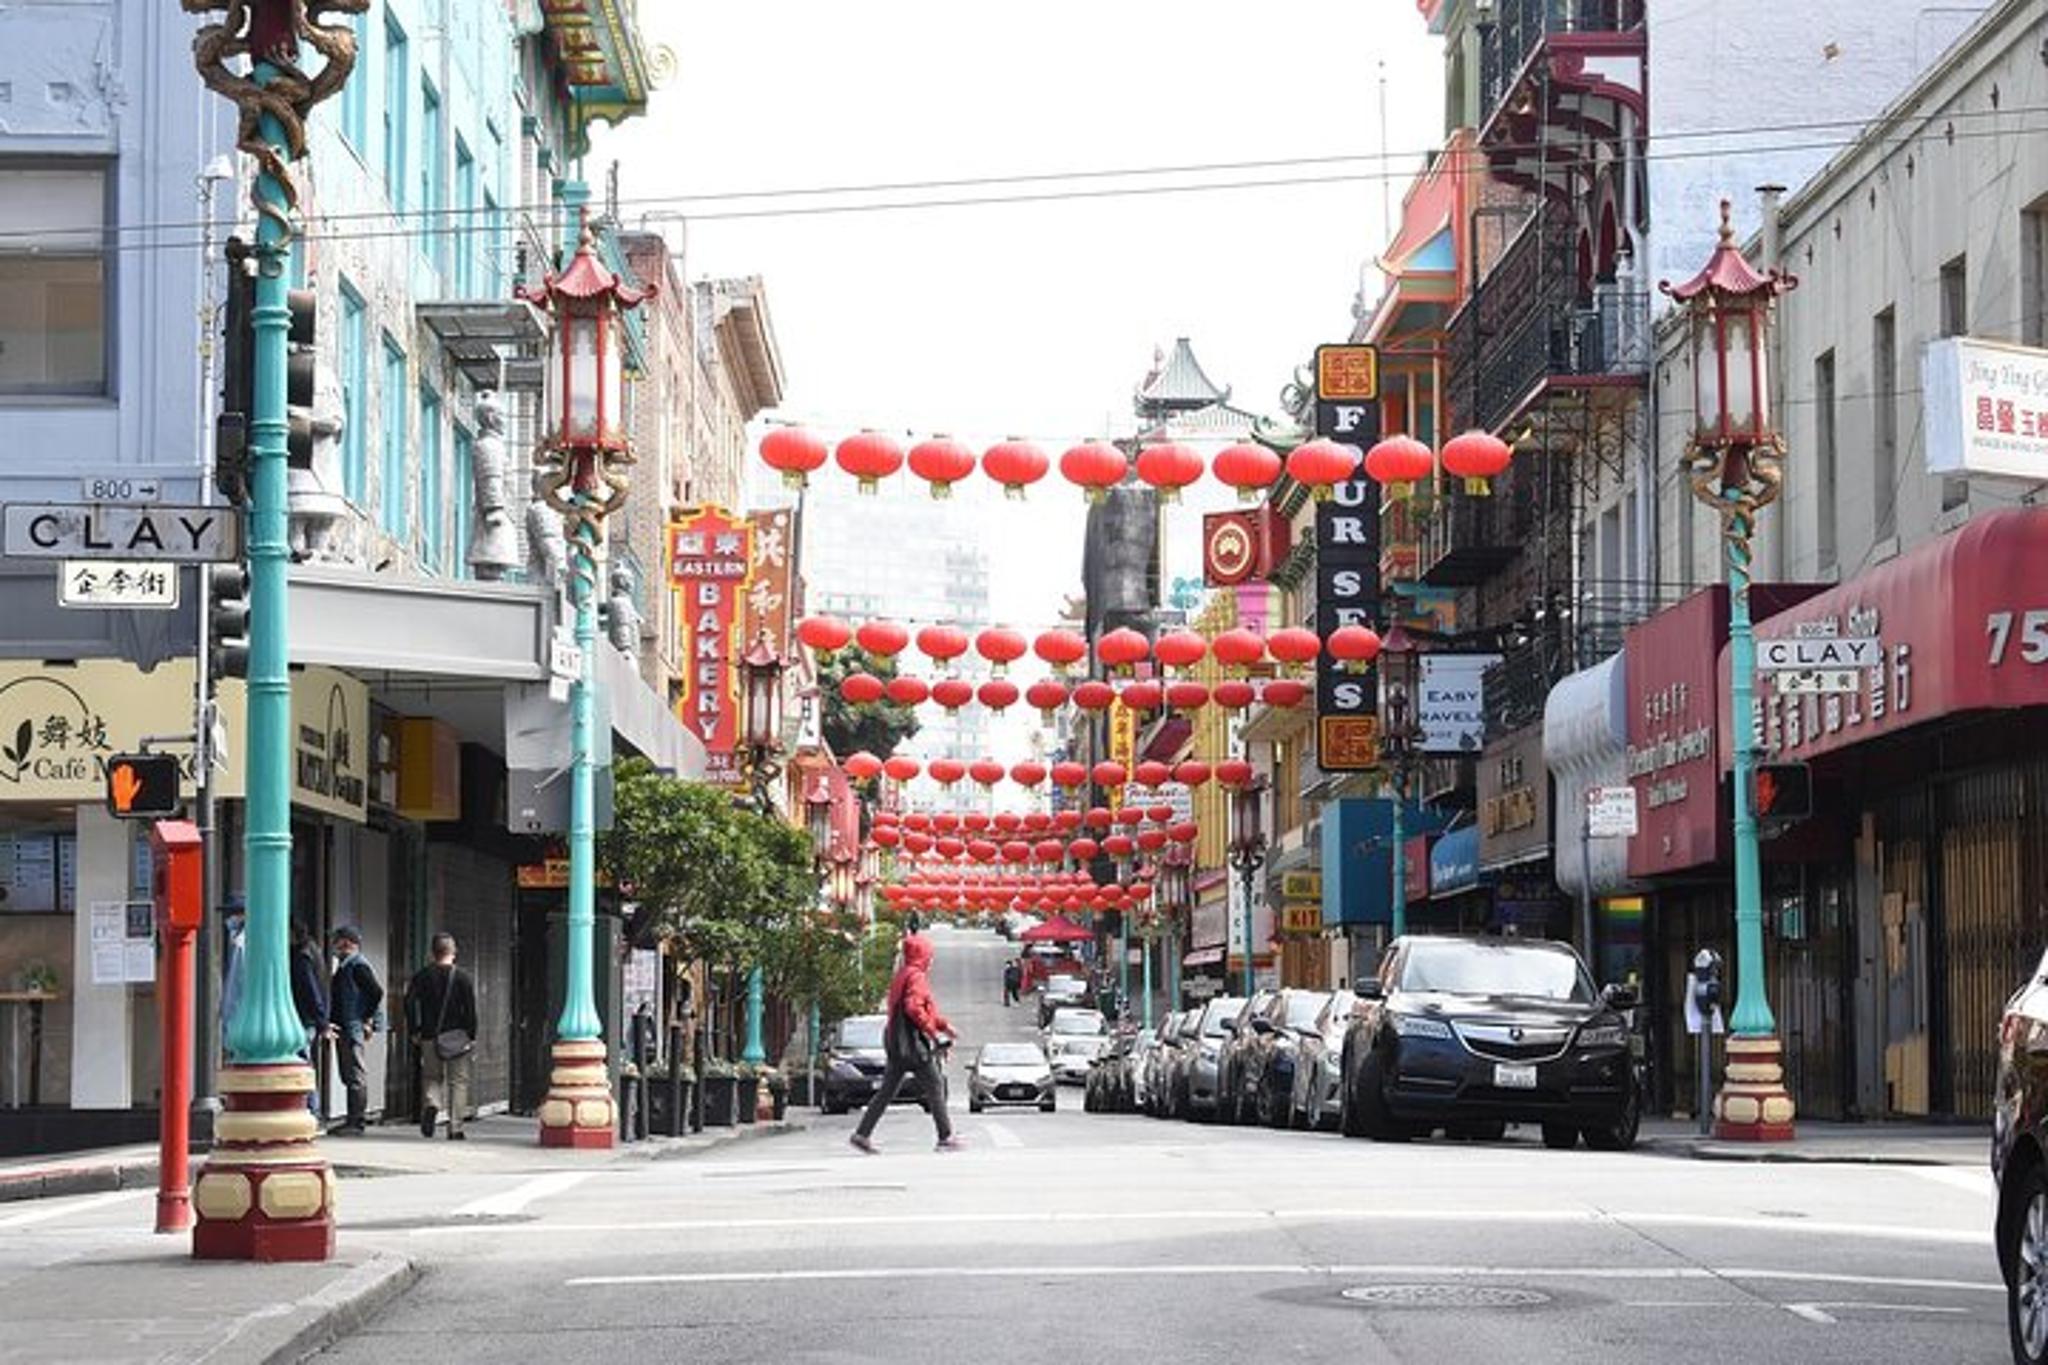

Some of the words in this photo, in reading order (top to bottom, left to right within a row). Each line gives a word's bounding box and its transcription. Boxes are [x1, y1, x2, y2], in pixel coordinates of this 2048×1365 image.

[1332, 405, 1366, 544] FUR
[93, 480, 131, 498] 800
[29, 514, 214, 551] CLAY
[673, 561, 746, 575] EASTERN
[696, 583, 720, 740] BAKERY
[1768, 642, 1867, 664] CLAY
[33, 757, 86, 782] Café
